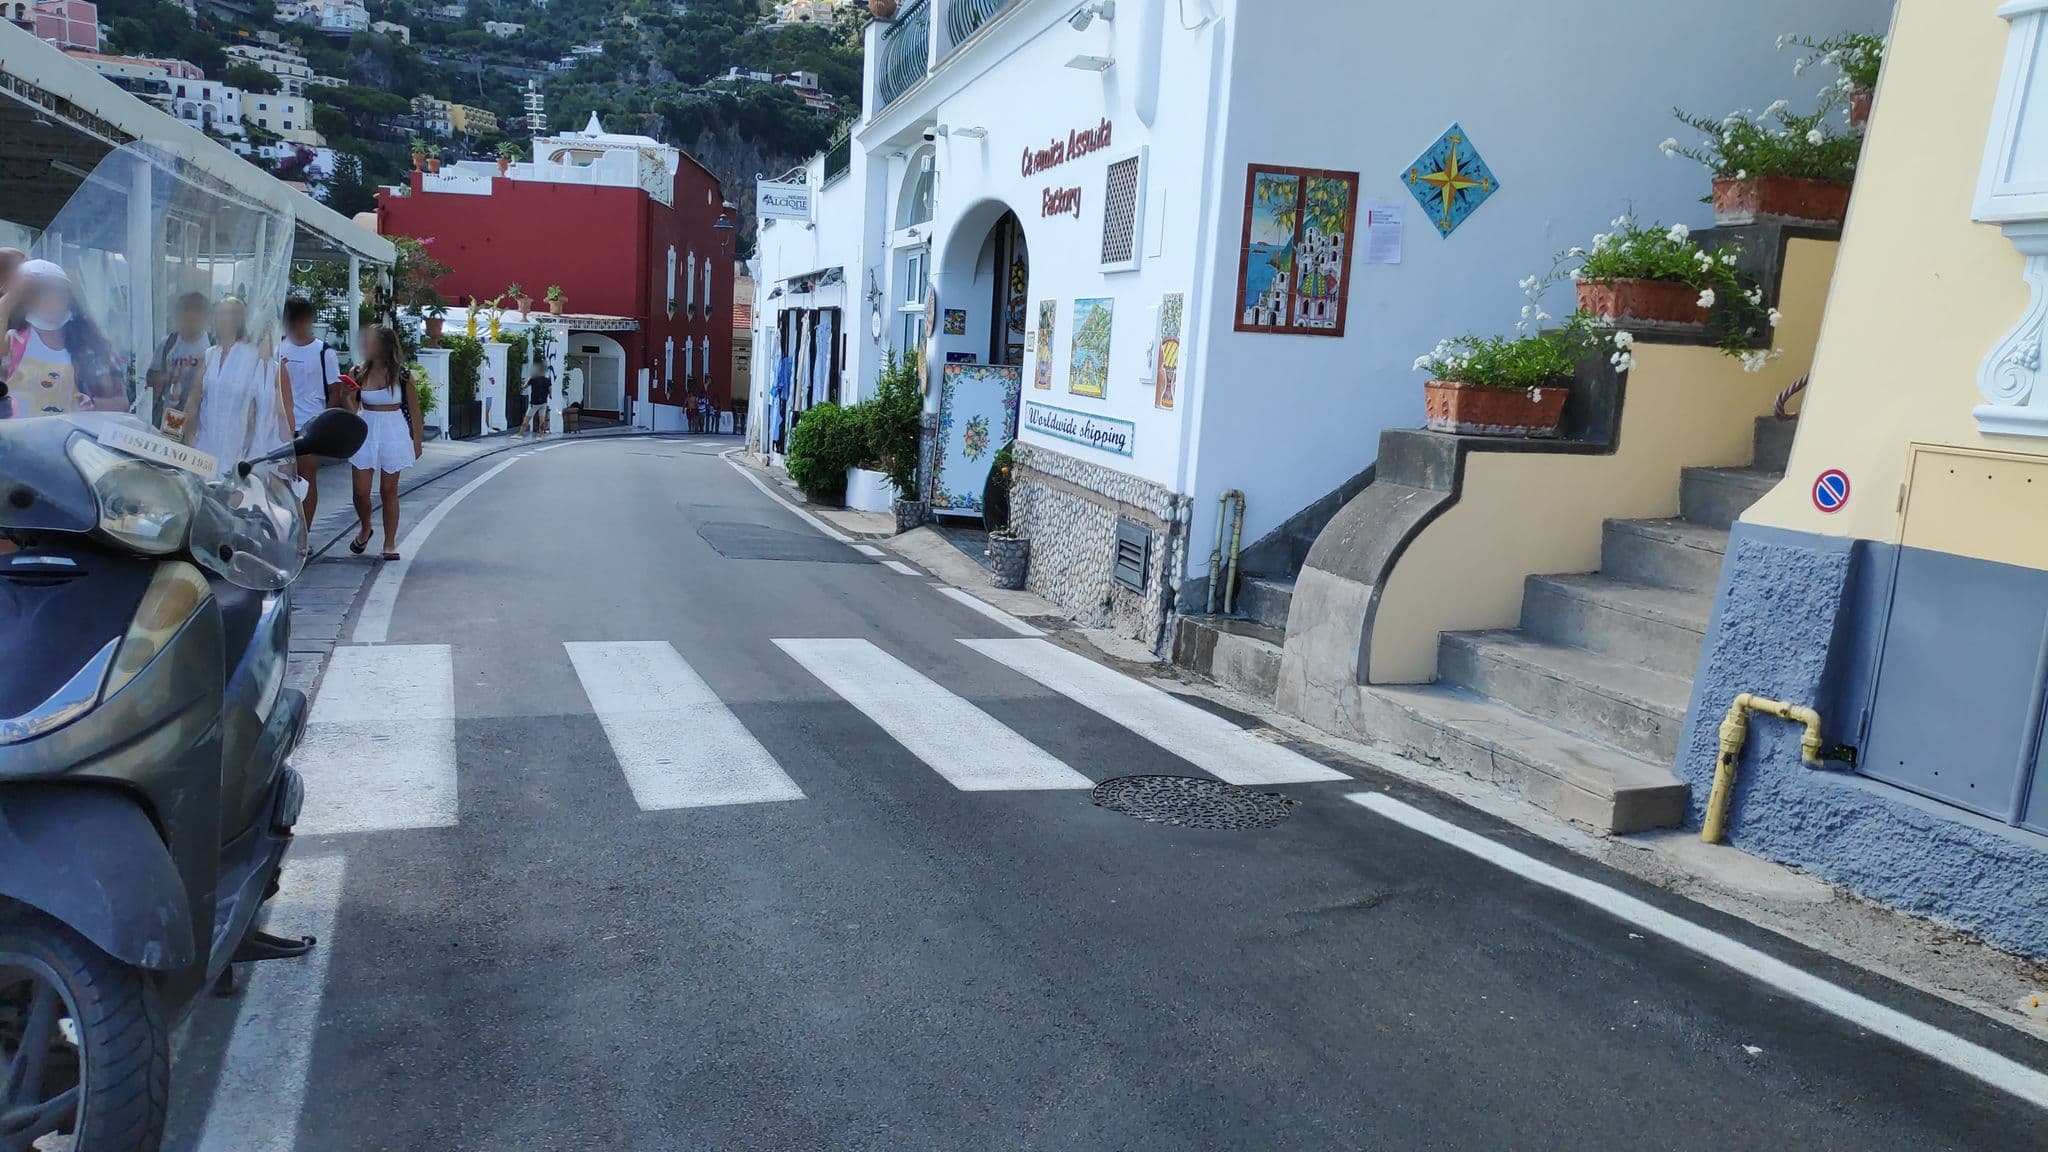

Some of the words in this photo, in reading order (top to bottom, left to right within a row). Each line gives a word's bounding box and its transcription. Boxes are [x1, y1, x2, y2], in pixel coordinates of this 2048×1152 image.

[1041, 186, 1081, 219] Factory
[111, 430, 188, 462] POSITANO
[1029, 407, 1077, 435] Worldwide
[1080, 419, 1126, 452] shipping
